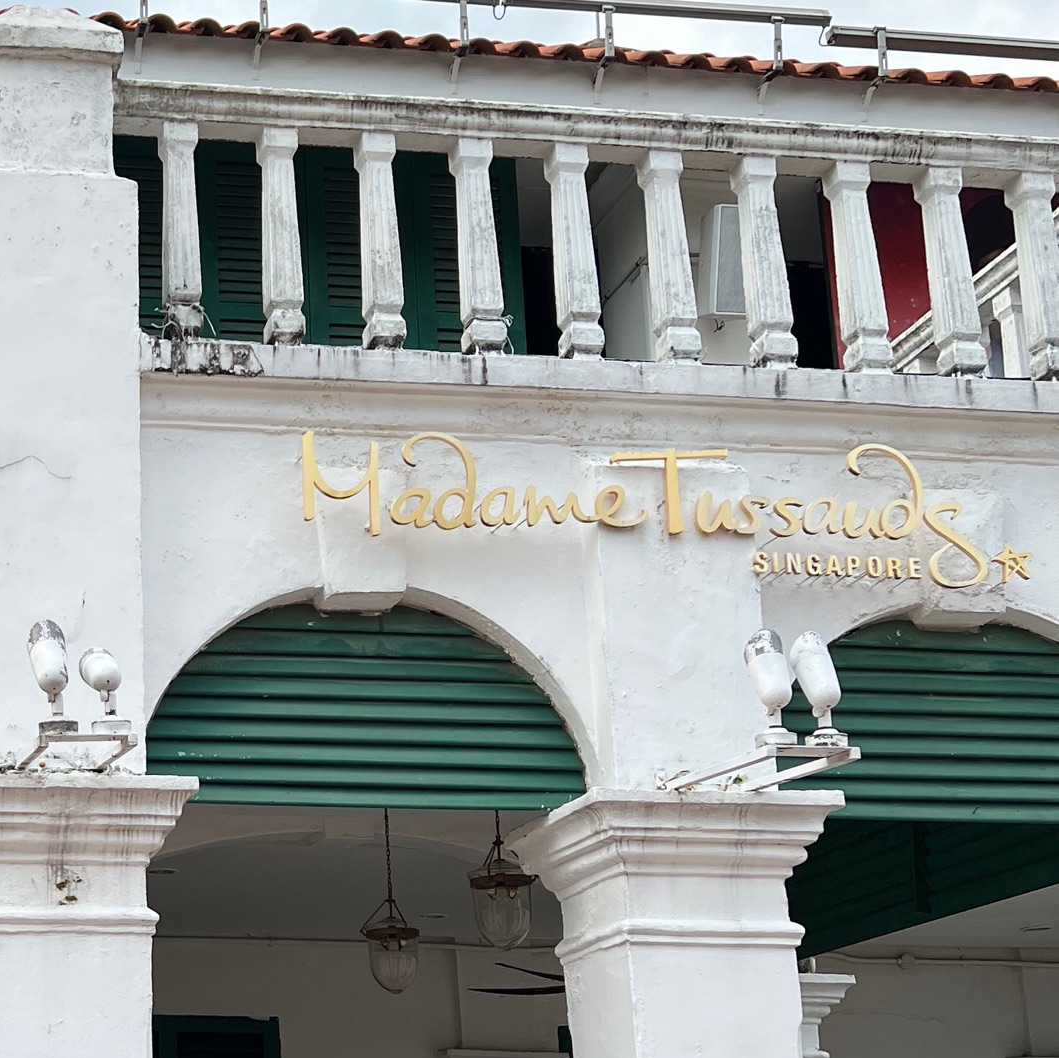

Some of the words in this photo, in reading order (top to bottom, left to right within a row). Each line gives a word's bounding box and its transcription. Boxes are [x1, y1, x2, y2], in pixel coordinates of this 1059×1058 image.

[300, 430, 650, 537] Madame
[610, 443, 991, 591] Tussauds
[752, 548, 924, 580] SINGAPORE
